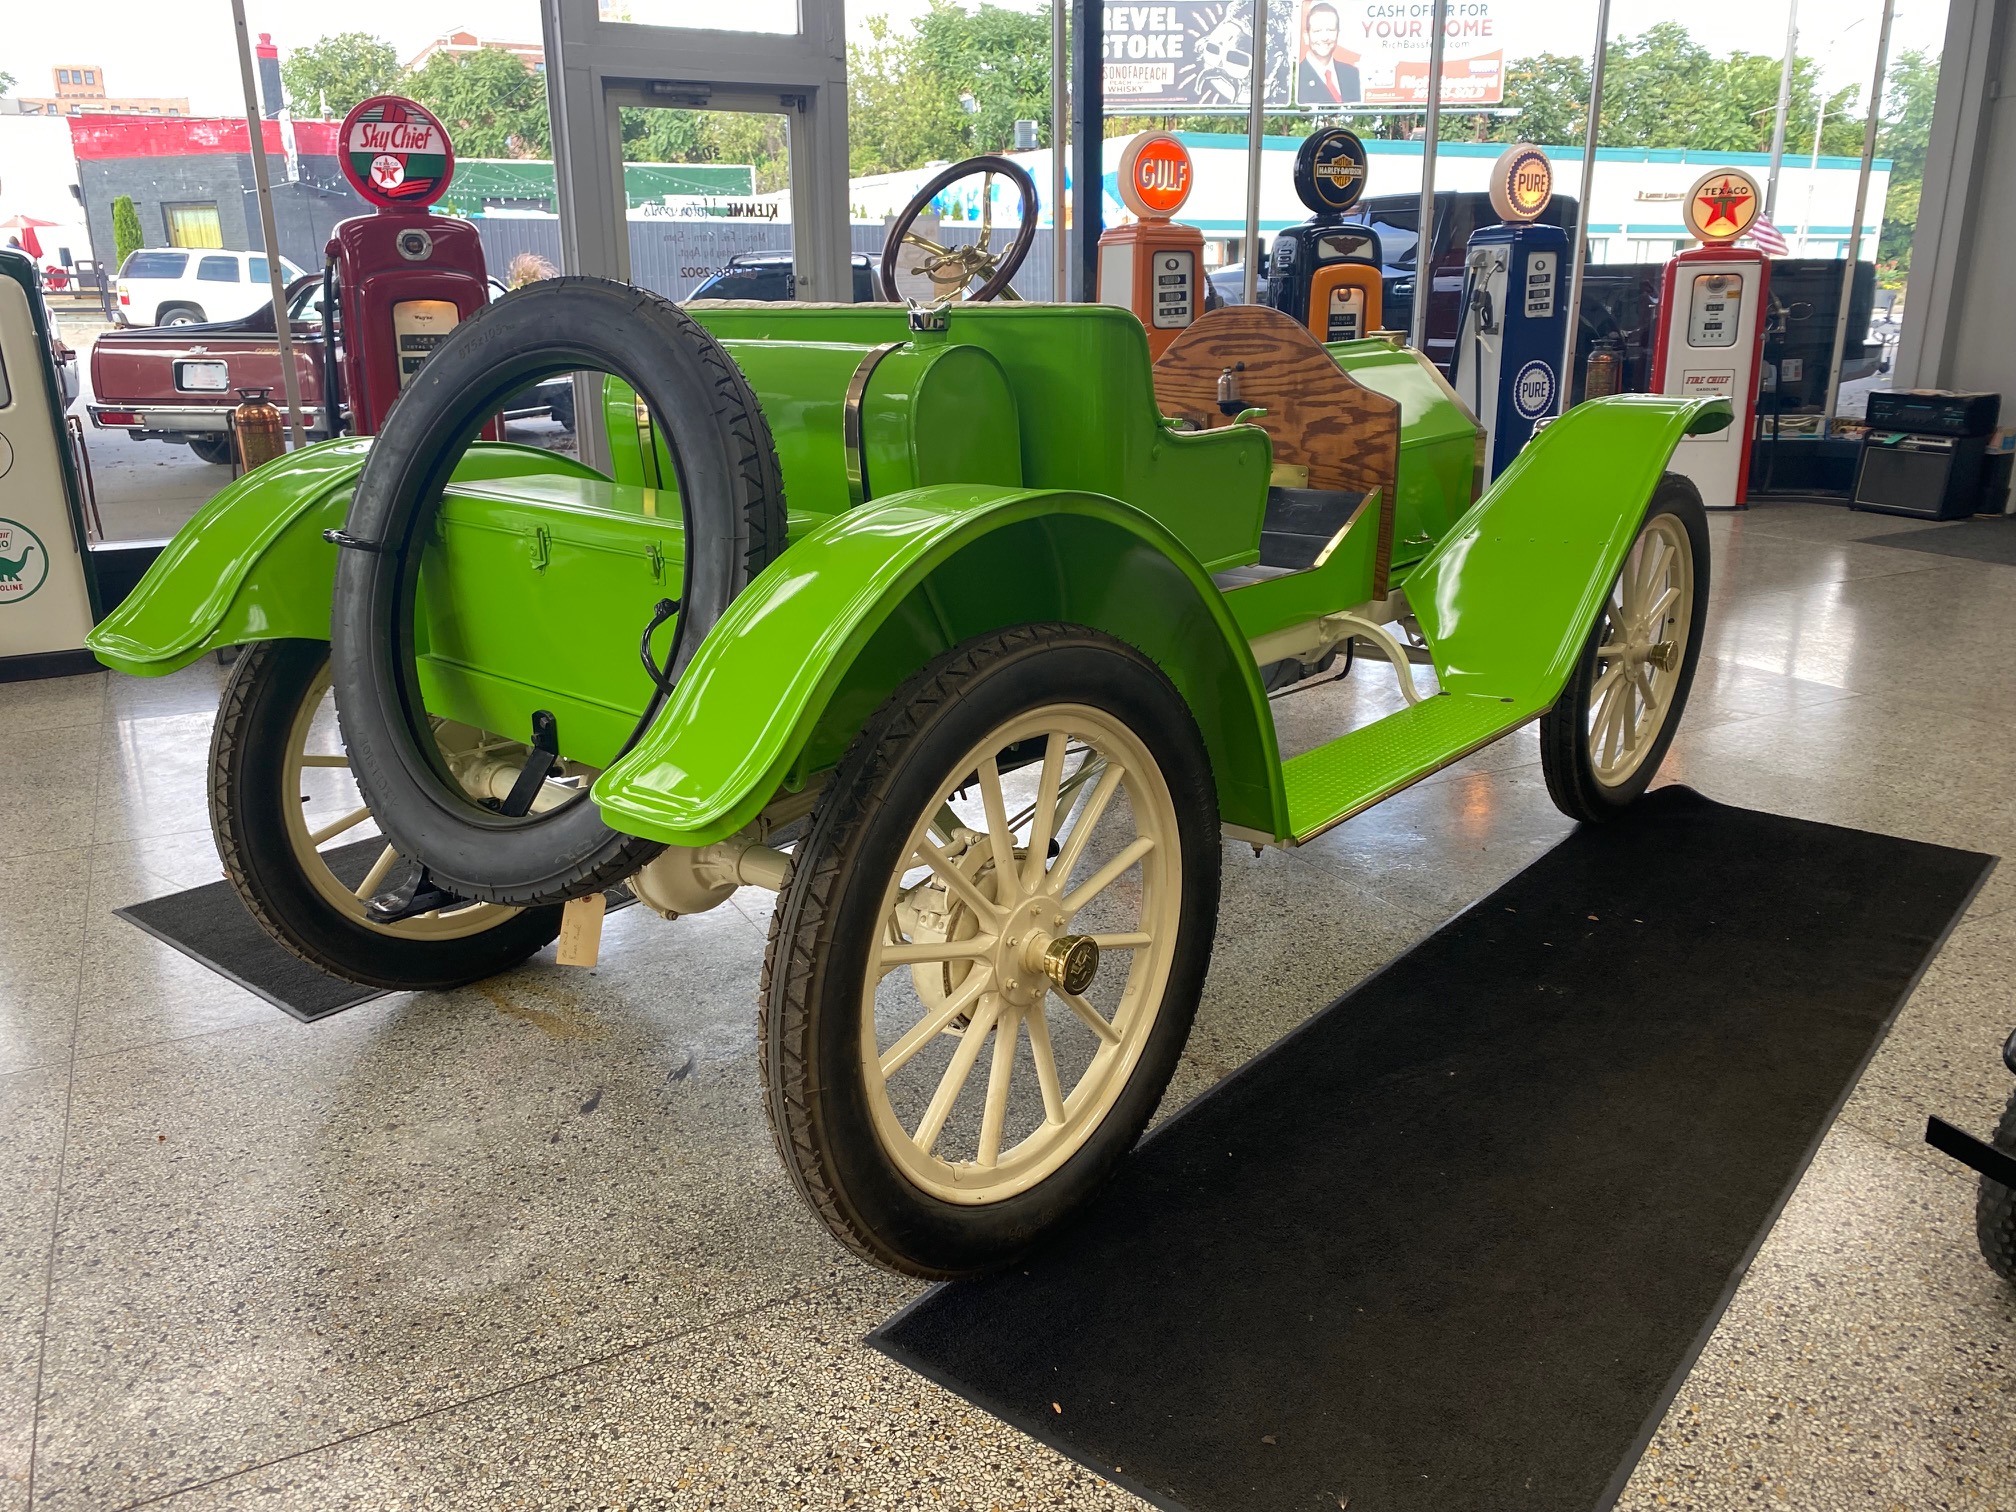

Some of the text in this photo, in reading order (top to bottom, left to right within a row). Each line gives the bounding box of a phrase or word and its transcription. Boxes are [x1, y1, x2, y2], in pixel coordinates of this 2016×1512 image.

[1367, 3, 1488, 18] CASH OFFR FOR
[1361, 19, 1493, 38] YOUR OME
[360, 123, 432, 151] Sky Chief
[1139, 157, 1187, 191] GULF
[1319, 166, 1362, 175] HARLEY-DAVIDSON
[1517, 173, 1546, 192] PURE
[1704, 186, 1748, 196] TEXACO
[1713, 197, 1737, 218] T
[1685, 375, 1731, 384] FIRE CHIEF
[1522, 381, 1547, 399] PURE
